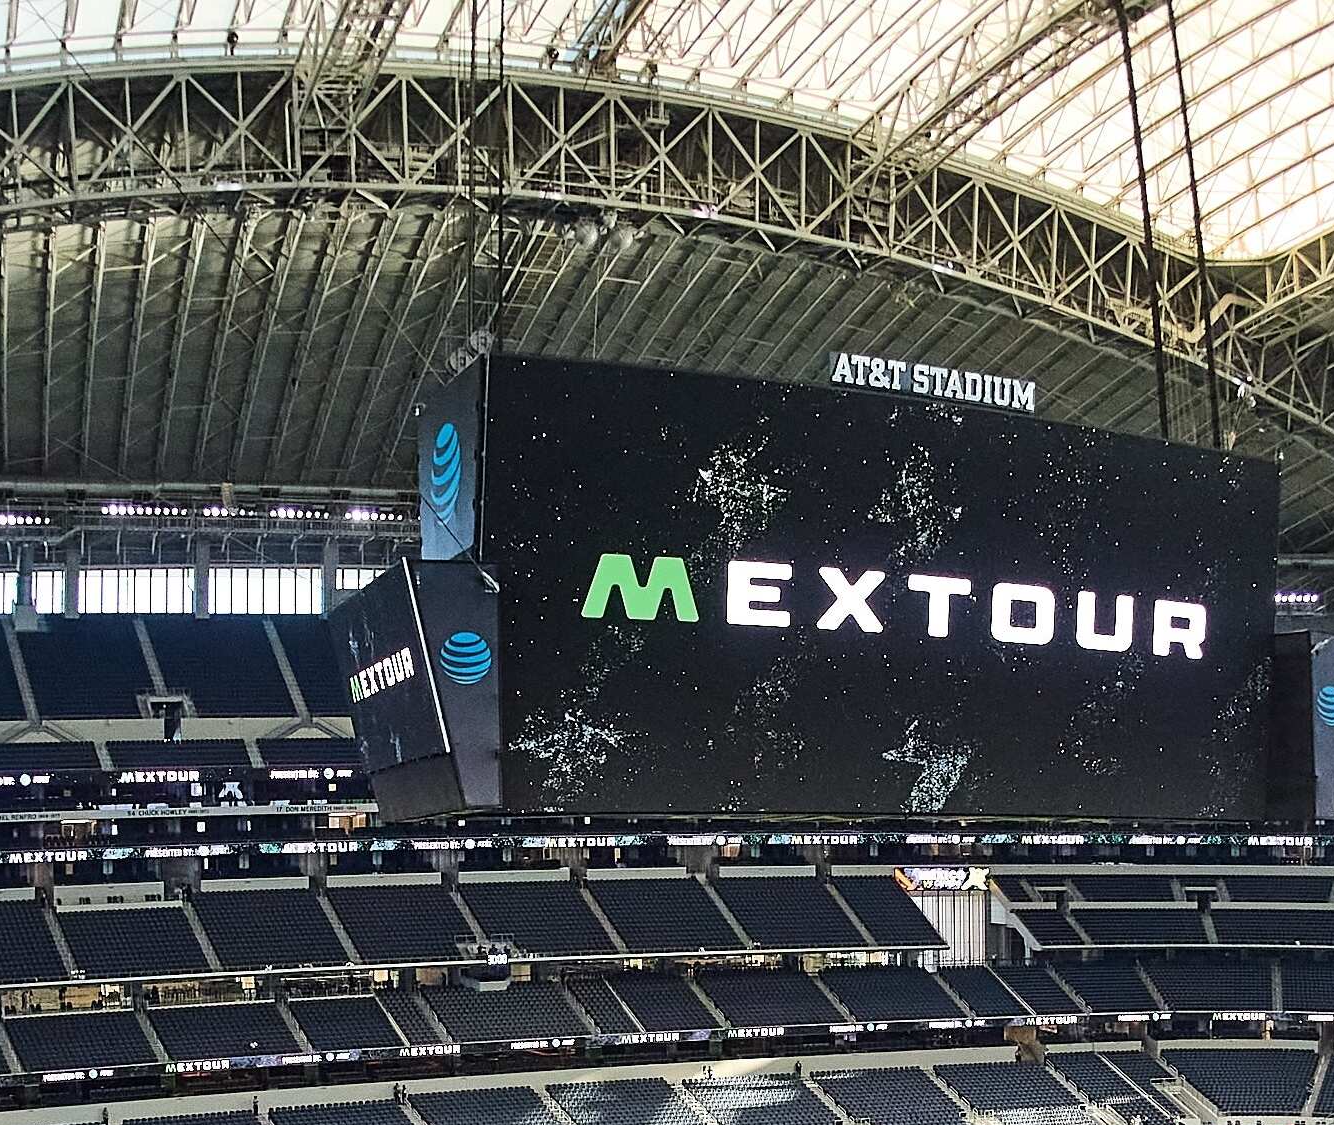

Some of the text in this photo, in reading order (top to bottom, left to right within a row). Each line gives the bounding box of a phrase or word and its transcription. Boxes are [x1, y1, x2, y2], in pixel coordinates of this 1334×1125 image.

[831, 352, 1036, 412] AT&T STADIUM
[580, 552, 1210, 661] MEXTOUR
[349, 645, 414, 705] MEXTOUR
[118, 770, 200, 784] MEXTOUR
[414, 840, 449, 850] PRESENTED
[544, 836, 616, 848] MEXTOUR
[791, 834, 858, 845] MEXTOUR
[1021, 834, 1085, 845] MEXTOUR
[1247, 836, 1313, 846] MEXTOUR
[144, 848, 184, 859] PRESENTED
[282, 842, 358, 854] MEXTOUR
[8, 850, 88, 864] MEXTOUR
[1025, 1015, 1078, 1026] MEXTOUR
[1212, 1012, 1266, 1022] MEXTOUR
[621, 1032, 680, 1044] MEXTOUR
[727, 1027, 785, 1038] MEXTOUR
[399, 1044, 461, 1057] MEXTOUR
[165, 1059, 230, 1073] MEXTOUR
